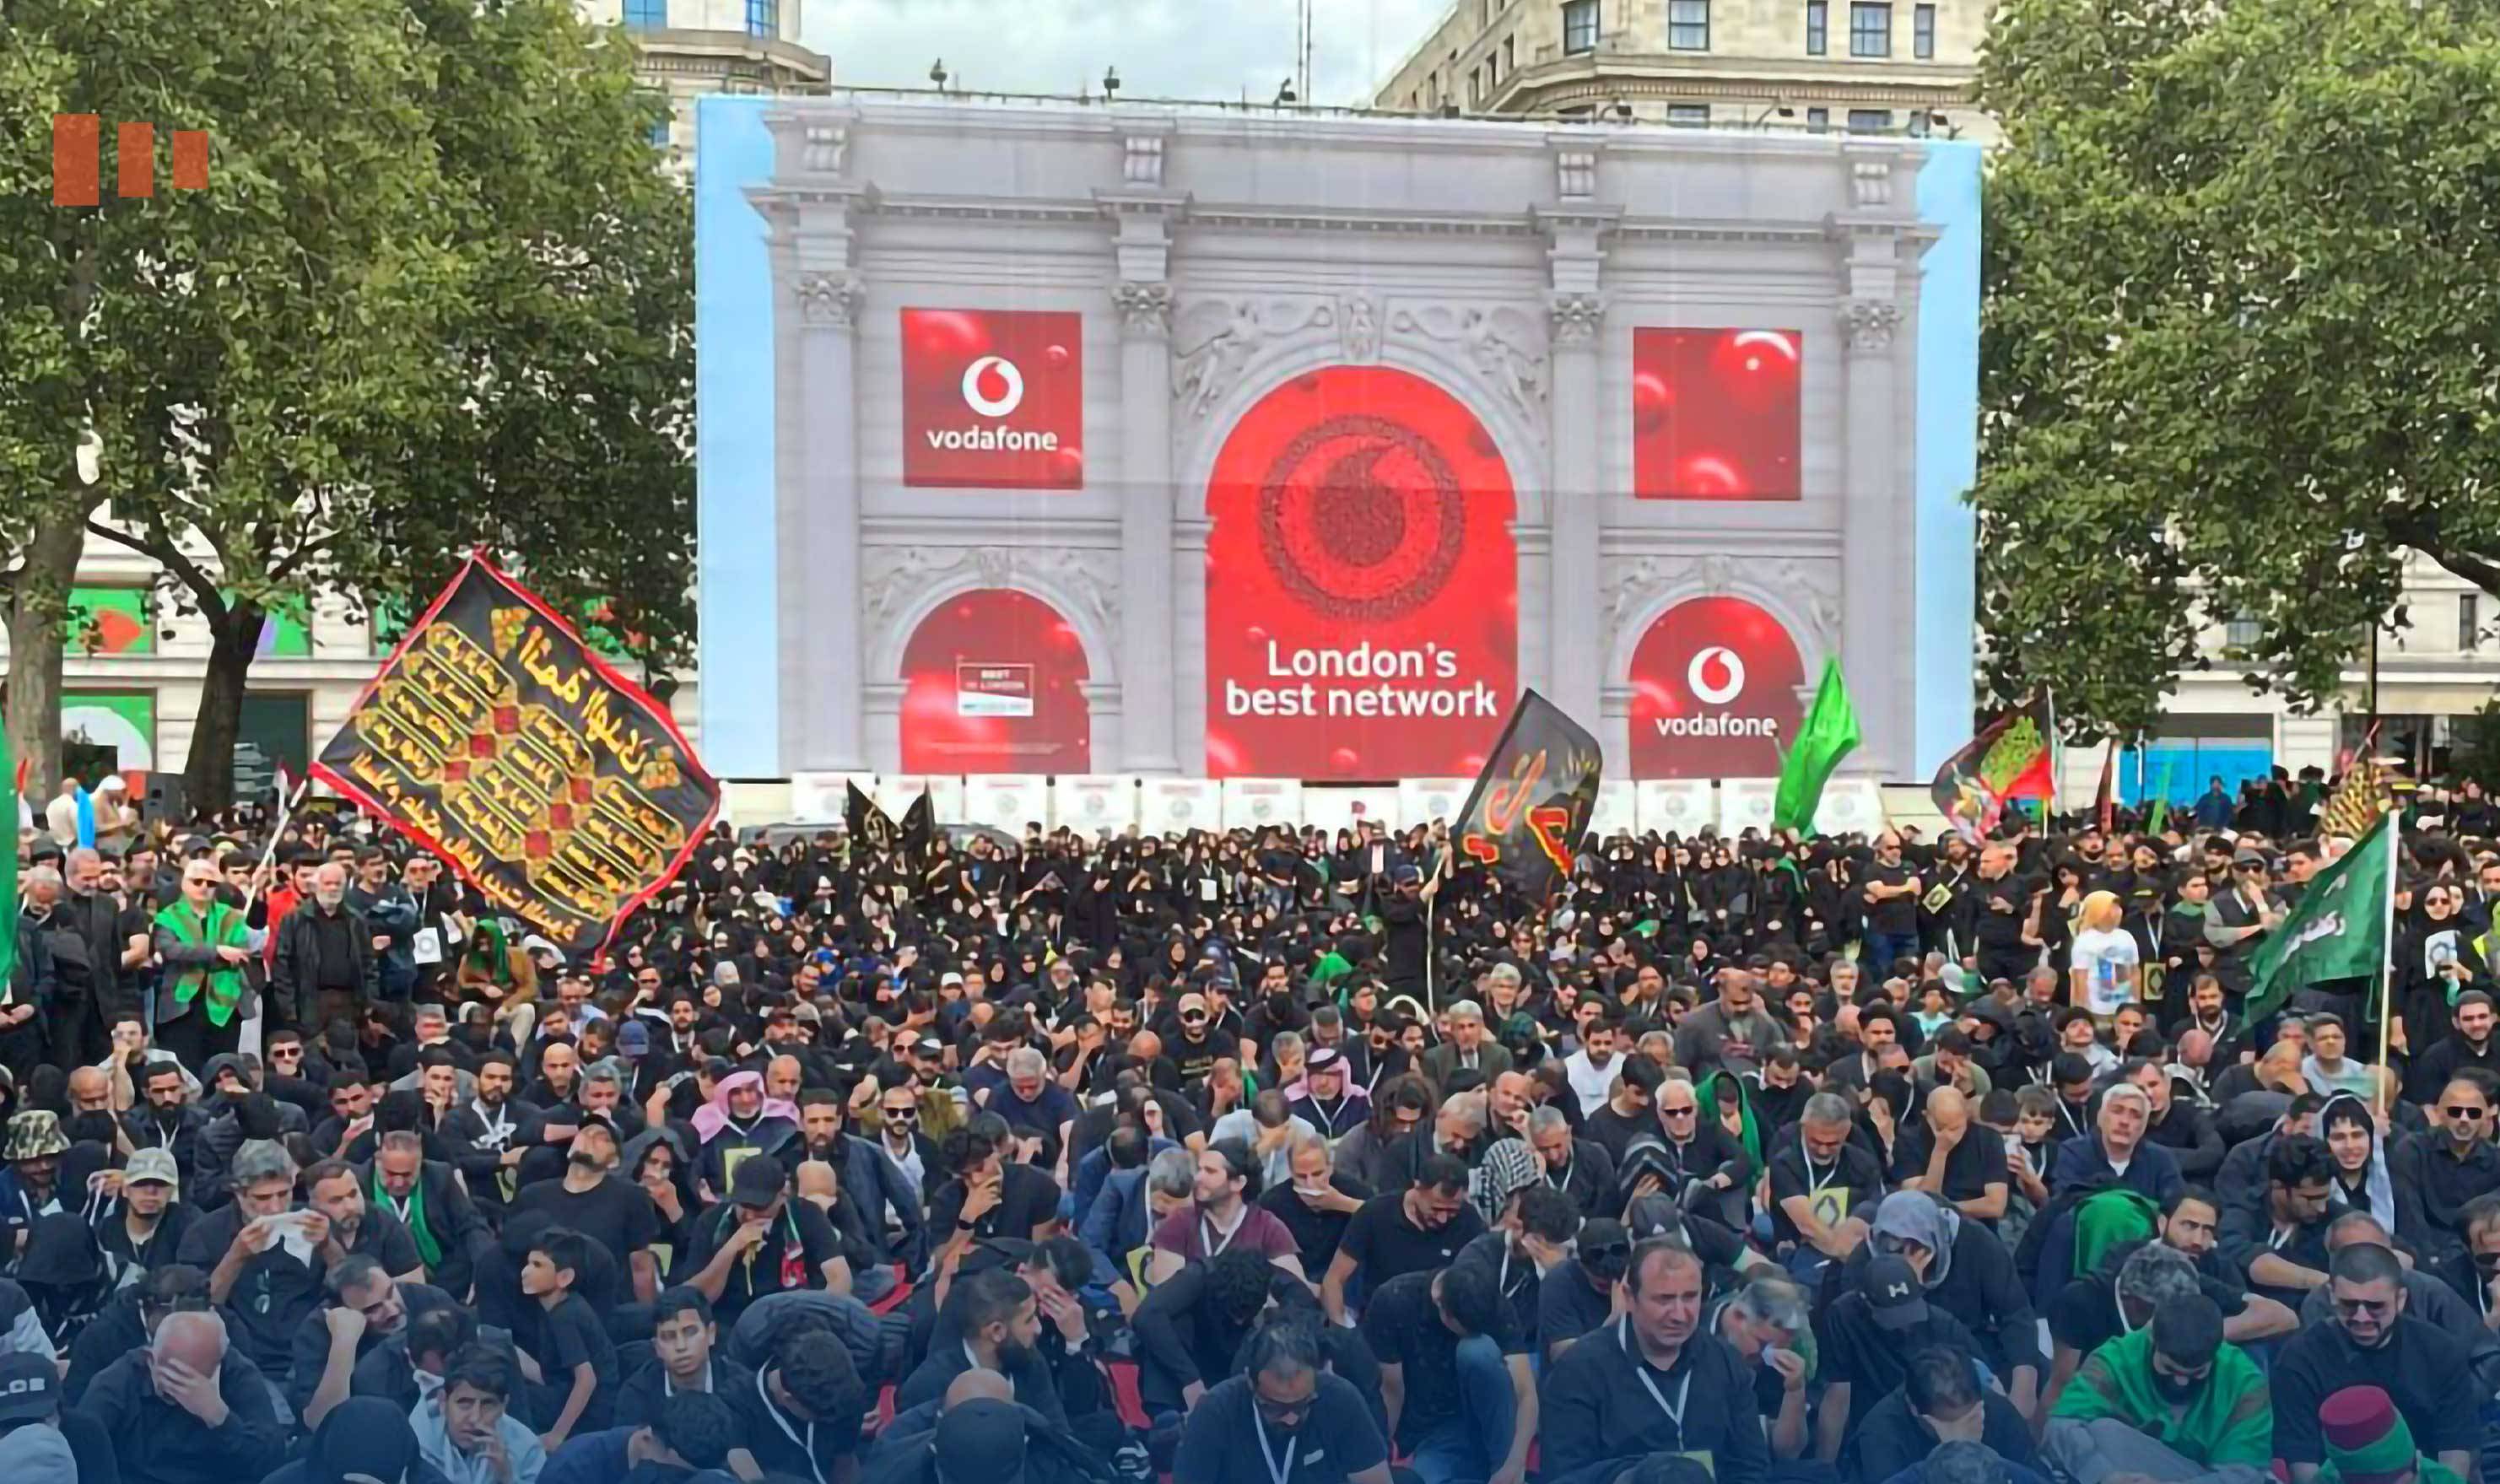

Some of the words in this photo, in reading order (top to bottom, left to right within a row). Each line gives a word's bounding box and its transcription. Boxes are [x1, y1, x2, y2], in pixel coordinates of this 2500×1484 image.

[926, 425, 1058, 452] vodafone
[1268, 639, 1457, 677] London's
[1226, 678, 1317, 717] best
[1328, 680, 1498, 717] network
[1655, 712, 1779, 737] vodafone
